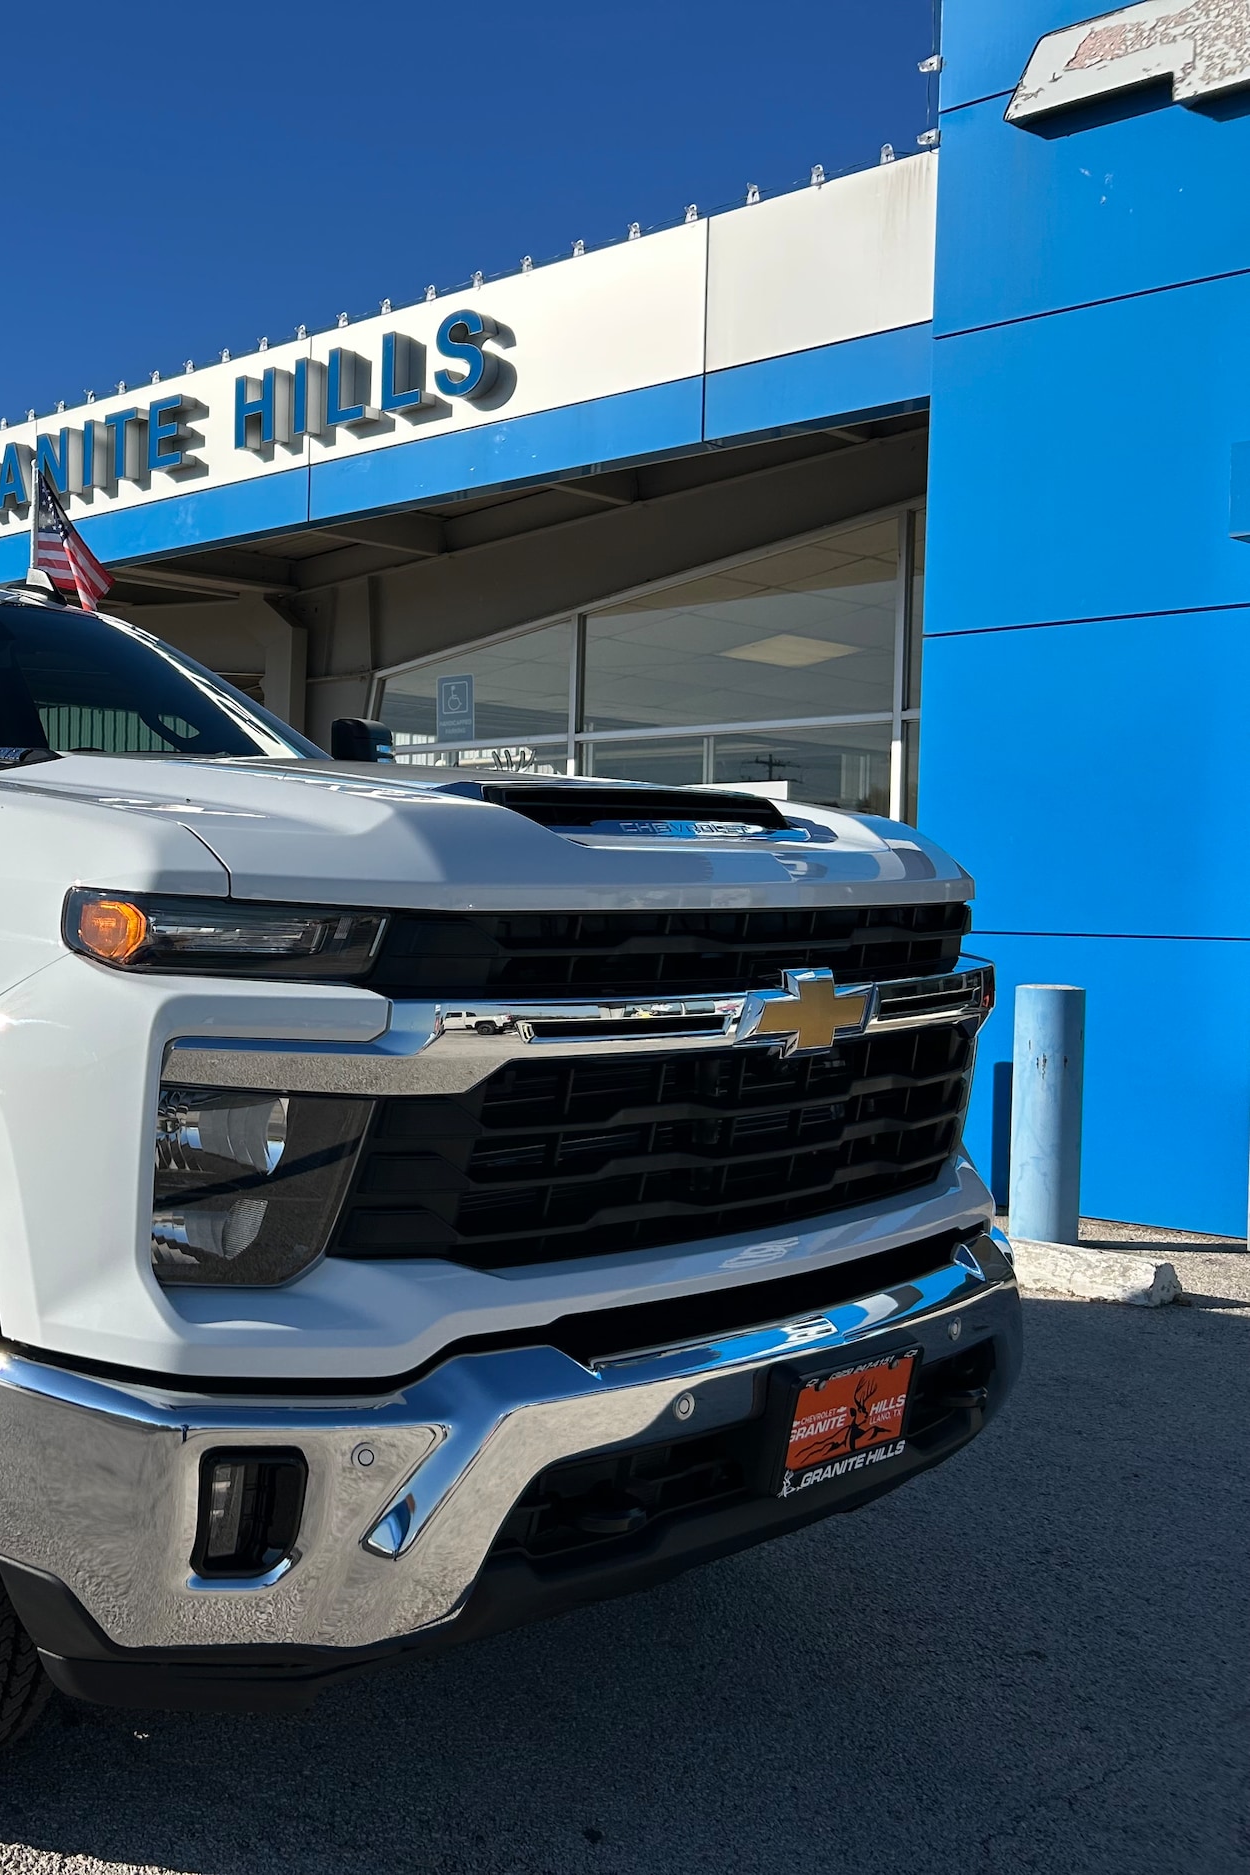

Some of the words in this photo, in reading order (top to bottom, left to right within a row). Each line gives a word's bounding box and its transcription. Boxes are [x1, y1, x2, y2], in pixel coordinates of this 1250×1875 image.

[234, 309, 495, 452] HILLS
[618, 821, 750, 836] CHEVROLET
[869, 1394, 906, 1417] HILLS
[893, 1408, 903, 1418] TX
[800, 1408, 837, 1425] CHEVROLET
[800, 1452, 867, 1488] GRANITE
[865, 1440, 906, 1467] HILLS
